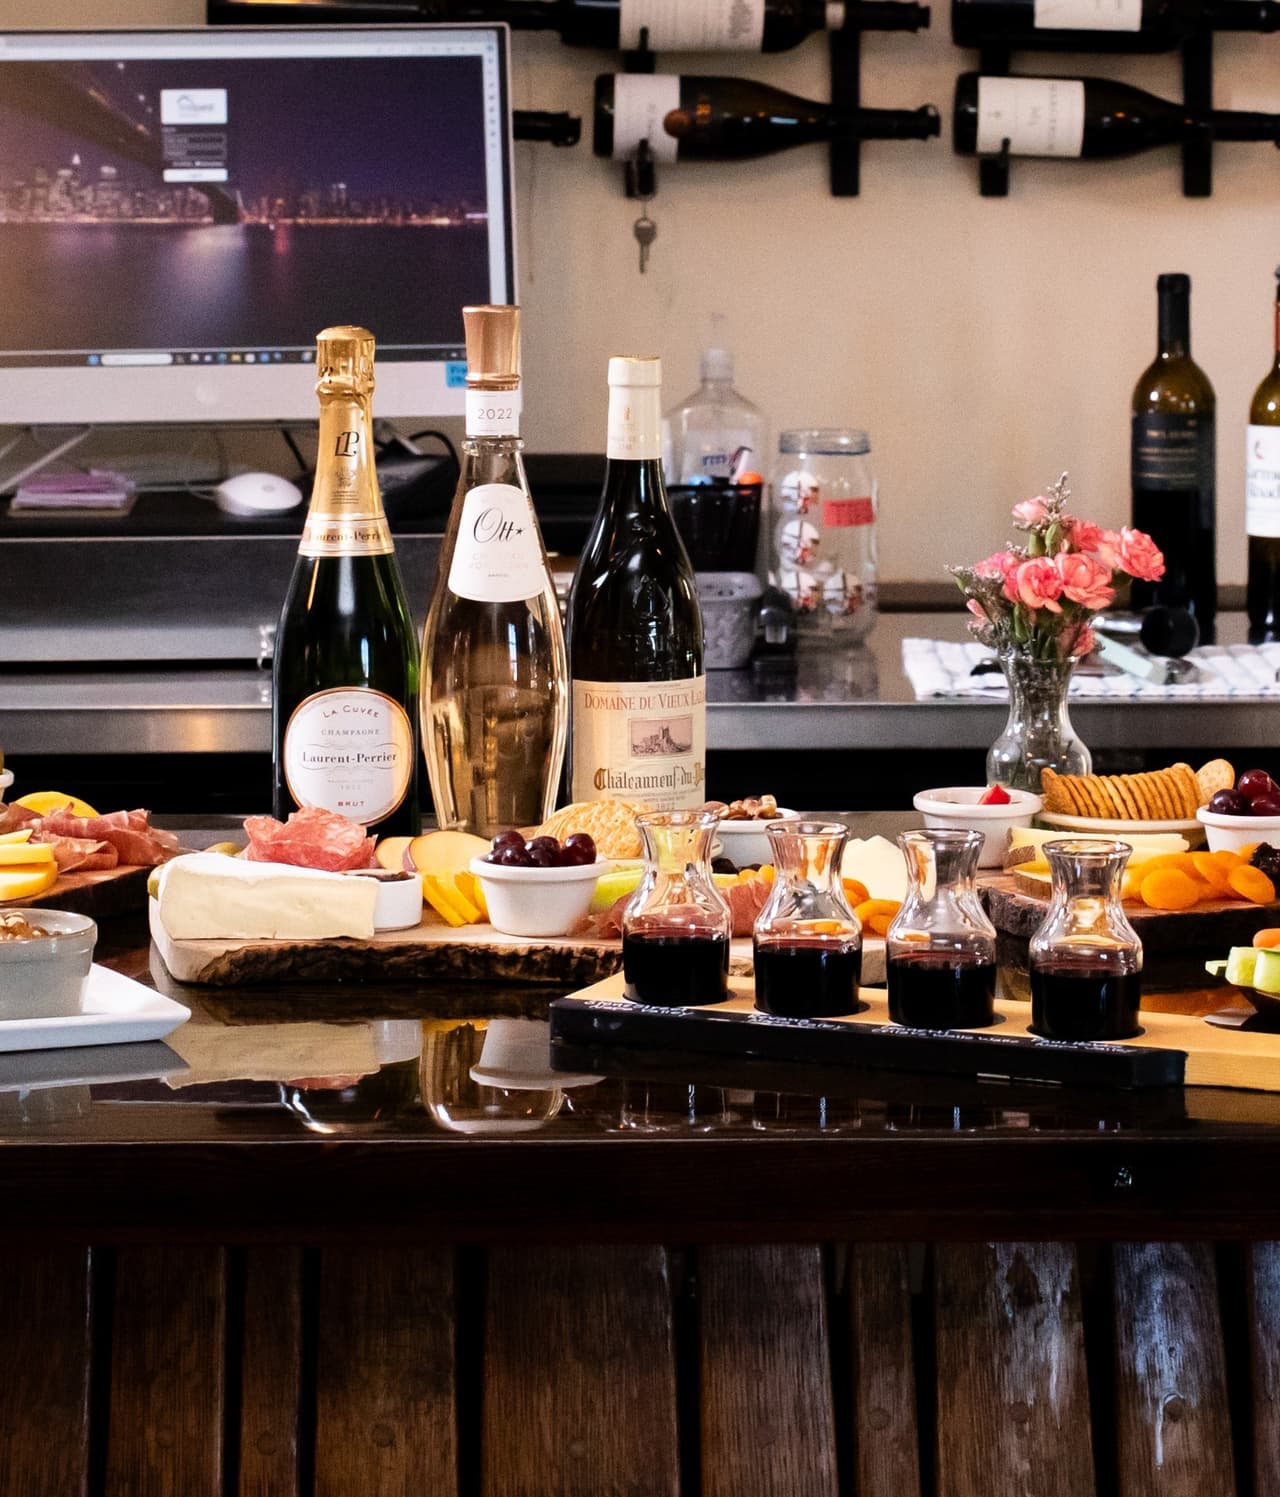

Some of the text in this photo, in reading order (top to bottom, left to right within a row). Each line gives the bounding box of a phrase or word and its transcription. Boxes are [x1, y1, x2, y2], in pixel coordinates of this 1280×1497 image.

[478, 408, 513, 420] 2022
[584, 693, 635, 711] DOMAINE
[639, 696, 655, 709] DU
[658, 692, 689, 709] VIEUX
[321, 729, 380, 737] CHAMPAGNE
[303, 751, 397, 764] Laurent-Perrier
